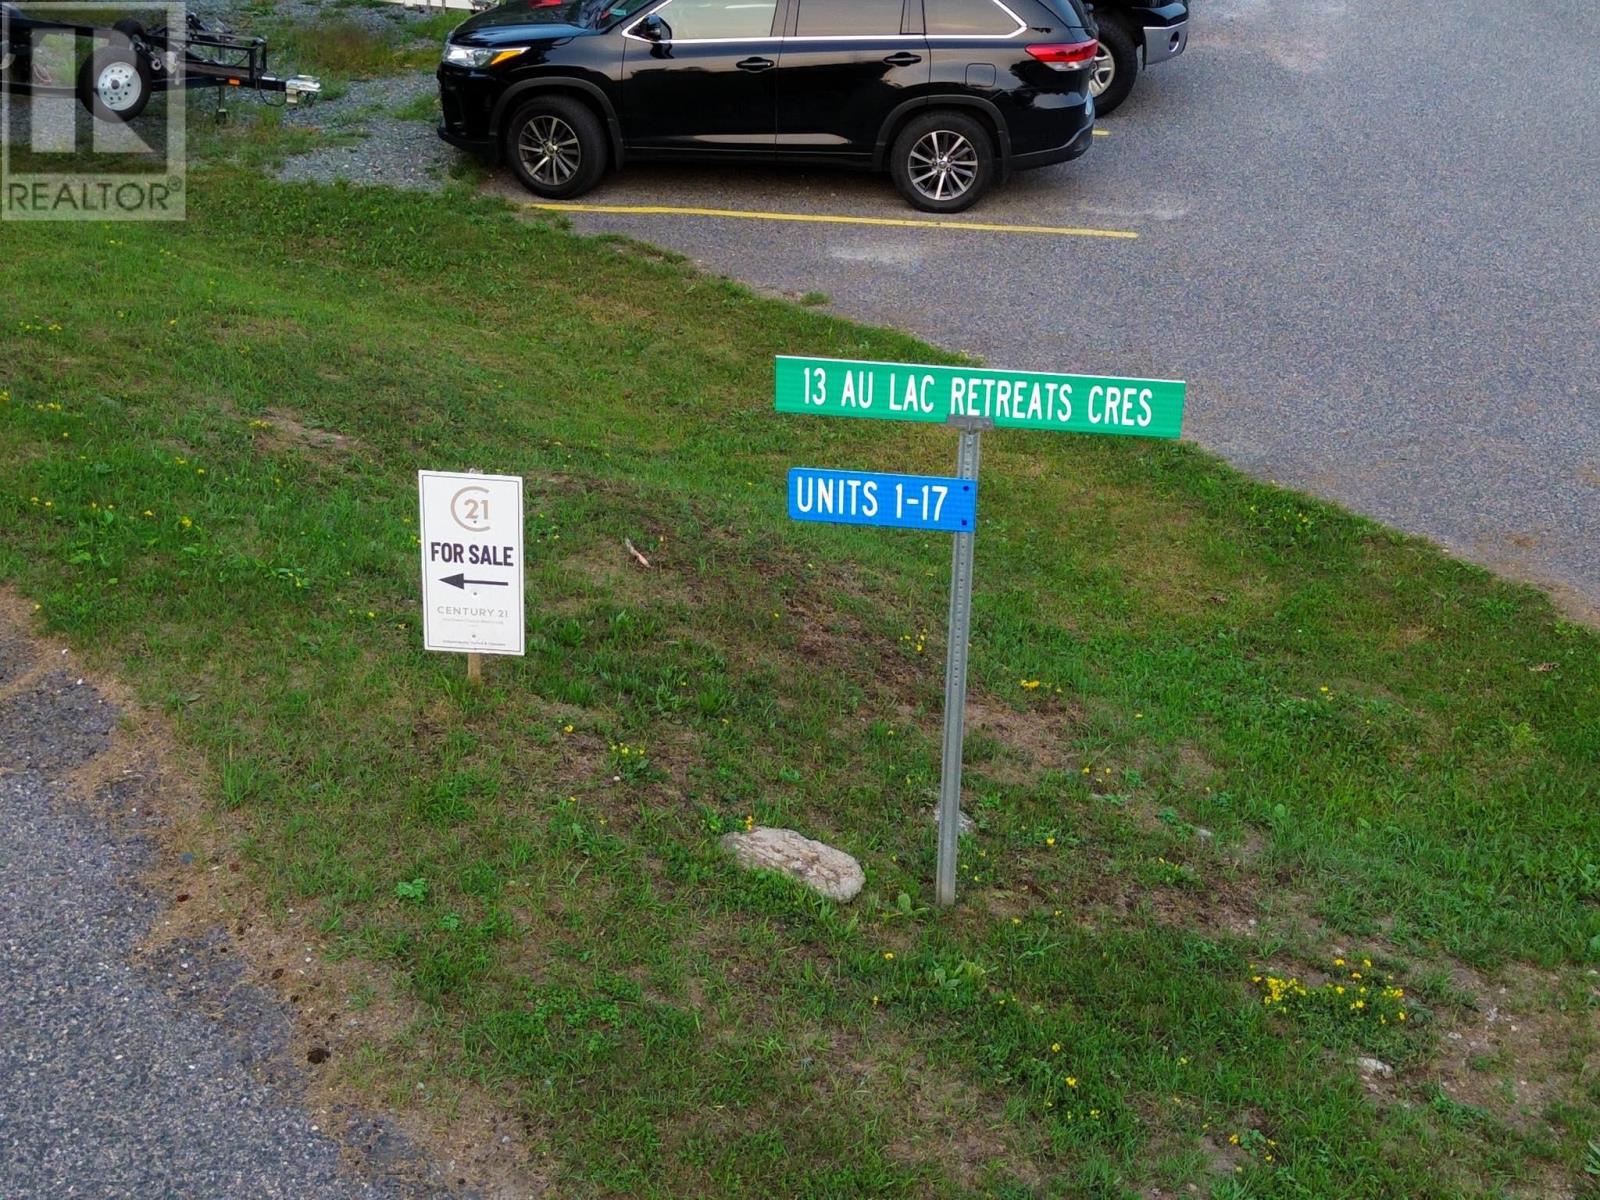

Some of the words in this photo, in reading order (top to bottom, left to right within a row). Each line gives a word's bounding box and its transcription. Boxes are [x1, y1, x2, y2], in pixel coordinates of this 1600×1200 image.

[803, 367, 827, 406] 13
[840, 370, 874, 409] AU
[888, 373, 935, 413] LAC
[950, 376, 1073, 422] RETREATS
[1087, 385, 1153, 427] CRES
[463, 498, 489, 520] 21
[796, 476, 879, 517] UNITS
[895, 483, 949, 522] 1-17
[430, 541, 464, 564] FOR
[468, 544, 514, 567] SALE
[436, 605, 495, 617] CENTURY
[497, 609, 509, 618] 21
